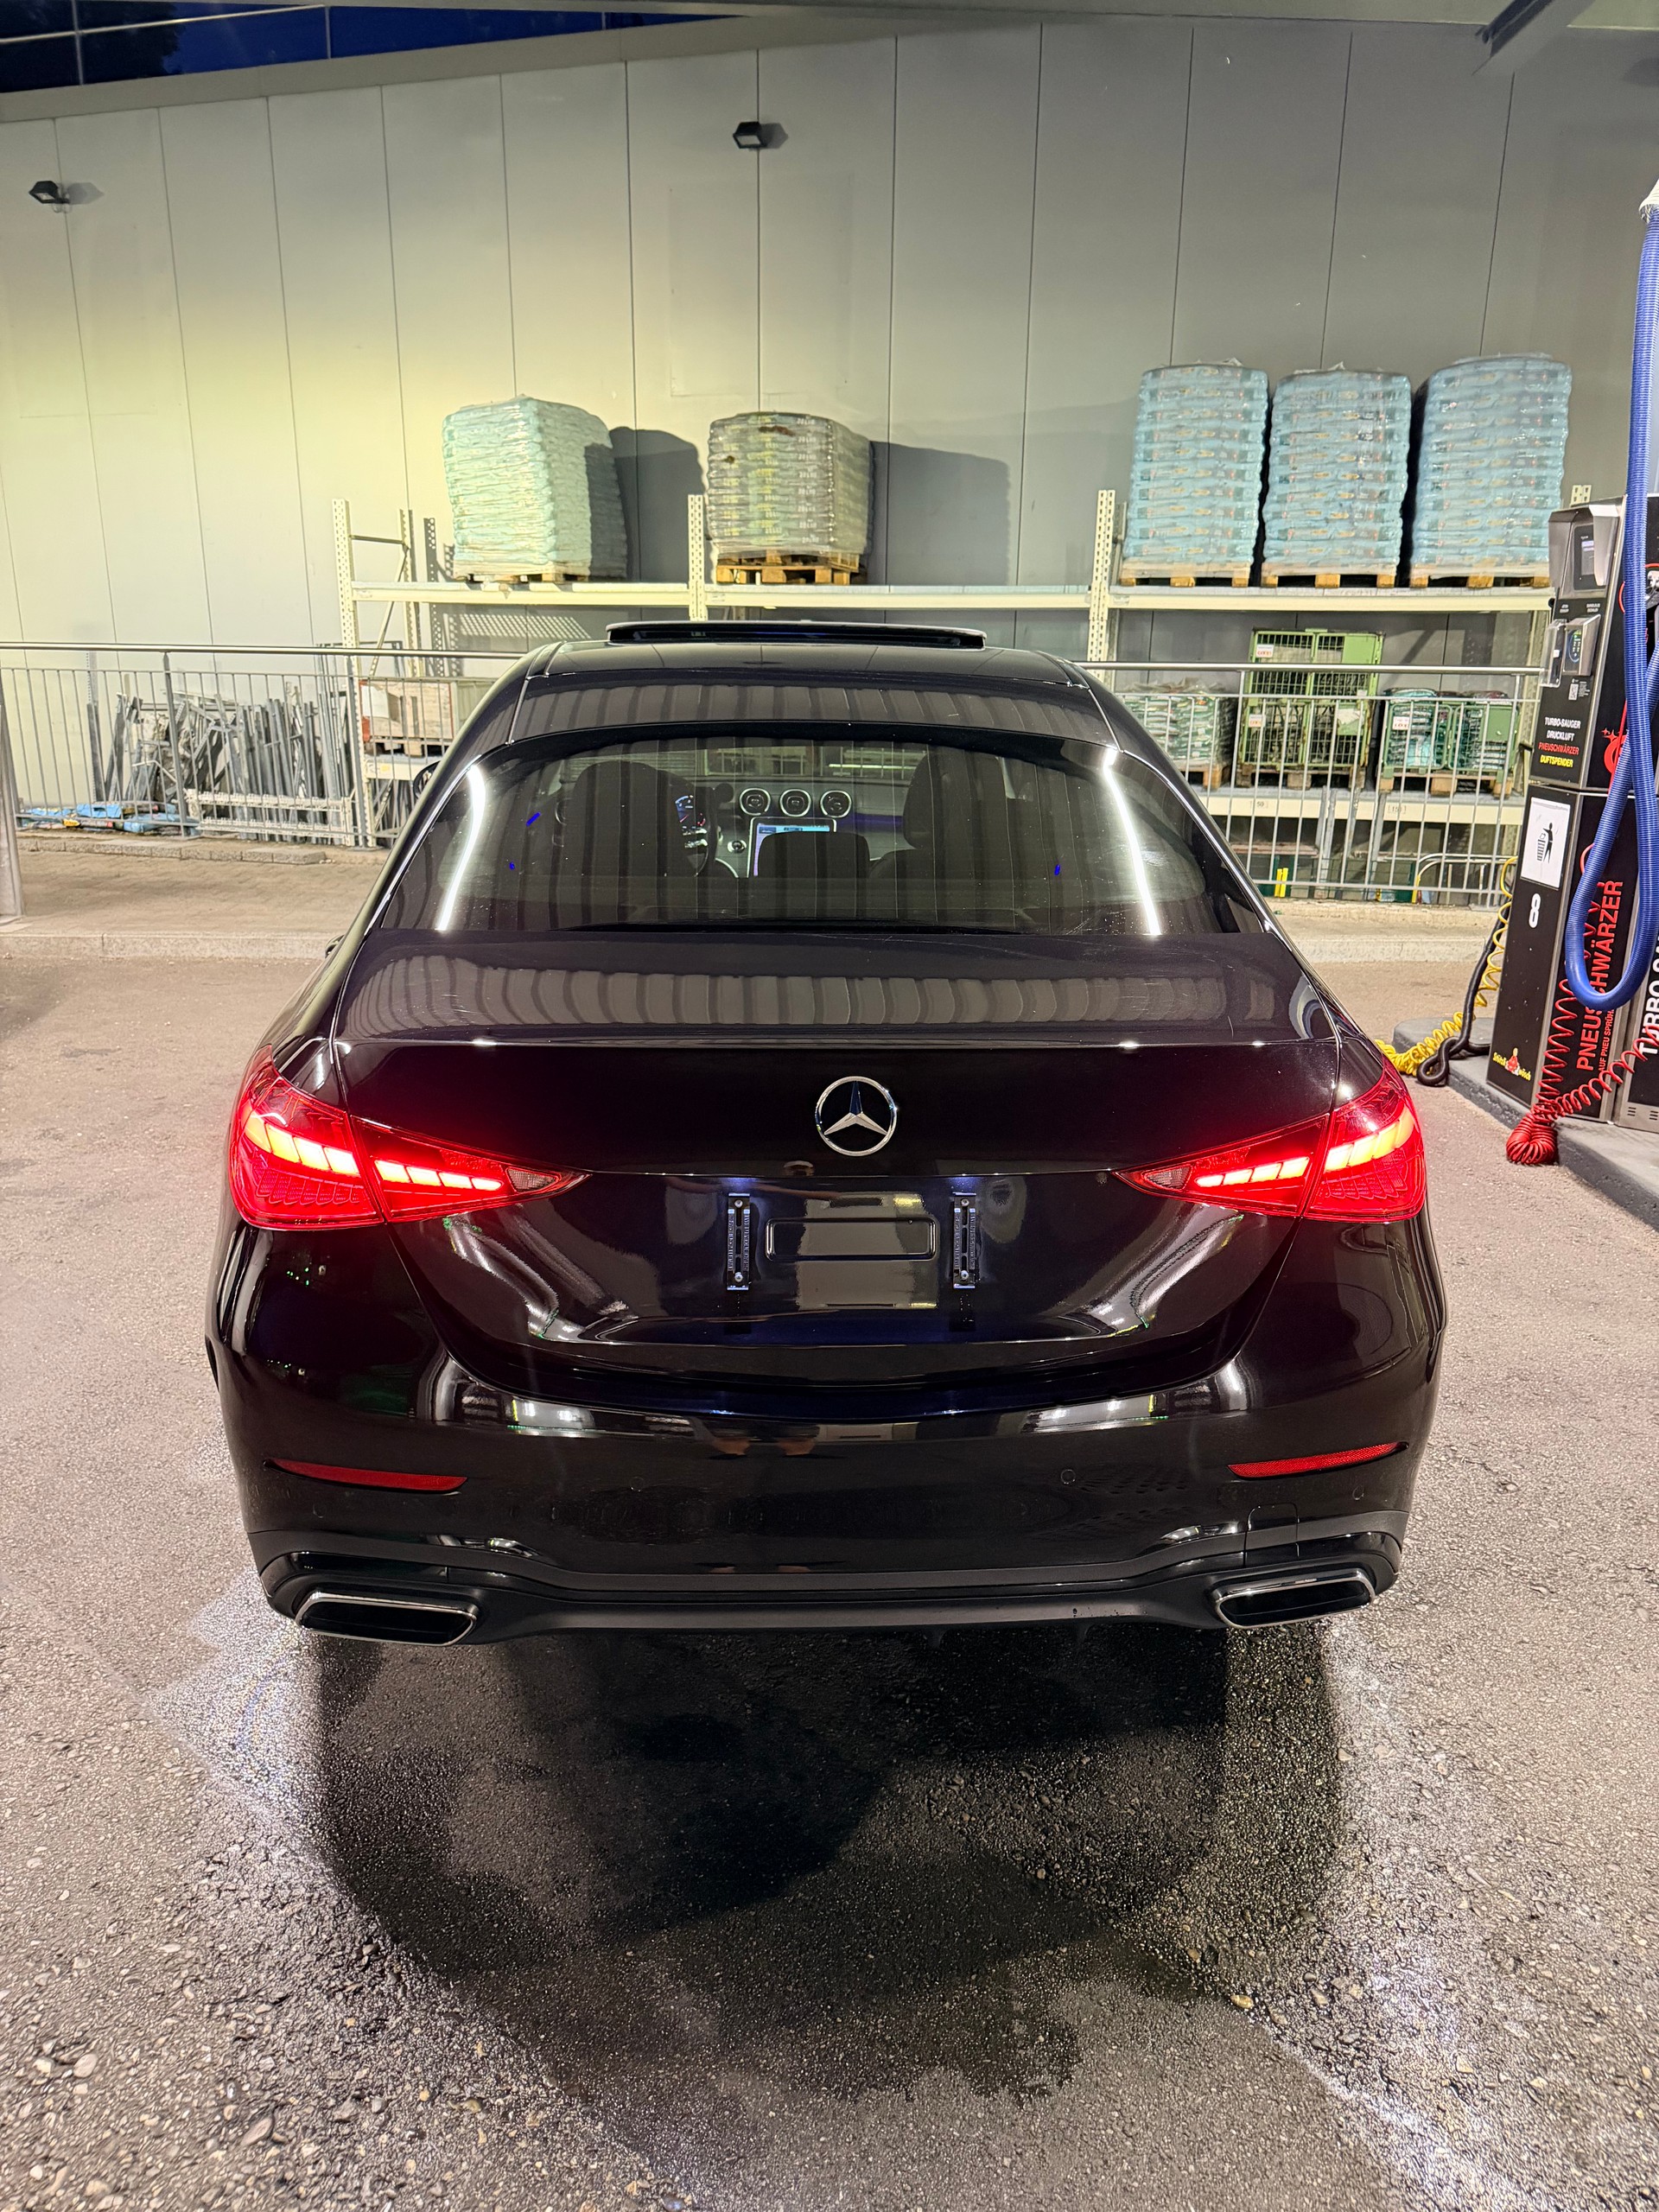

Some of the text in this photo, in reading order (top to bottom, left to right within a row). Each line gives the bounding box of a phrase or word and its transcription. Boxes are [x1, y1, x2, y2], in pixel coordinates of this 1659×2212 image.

[1544, 716, 1581, 729] TURBO-SAUGER
[1546, 729, 1575, 741] DRUCKLUFT
[1538, 741, 1580, 755] PNEUSCHWÄRZER
[1540, 754, 1573, 767] DUFTSPENDER
[1529, 893, 1541, 928] 8
[1576, 880, 1623, 1071] PNEUHWÄRZER
[1600, 1037, 1611, 1057] PNEU
